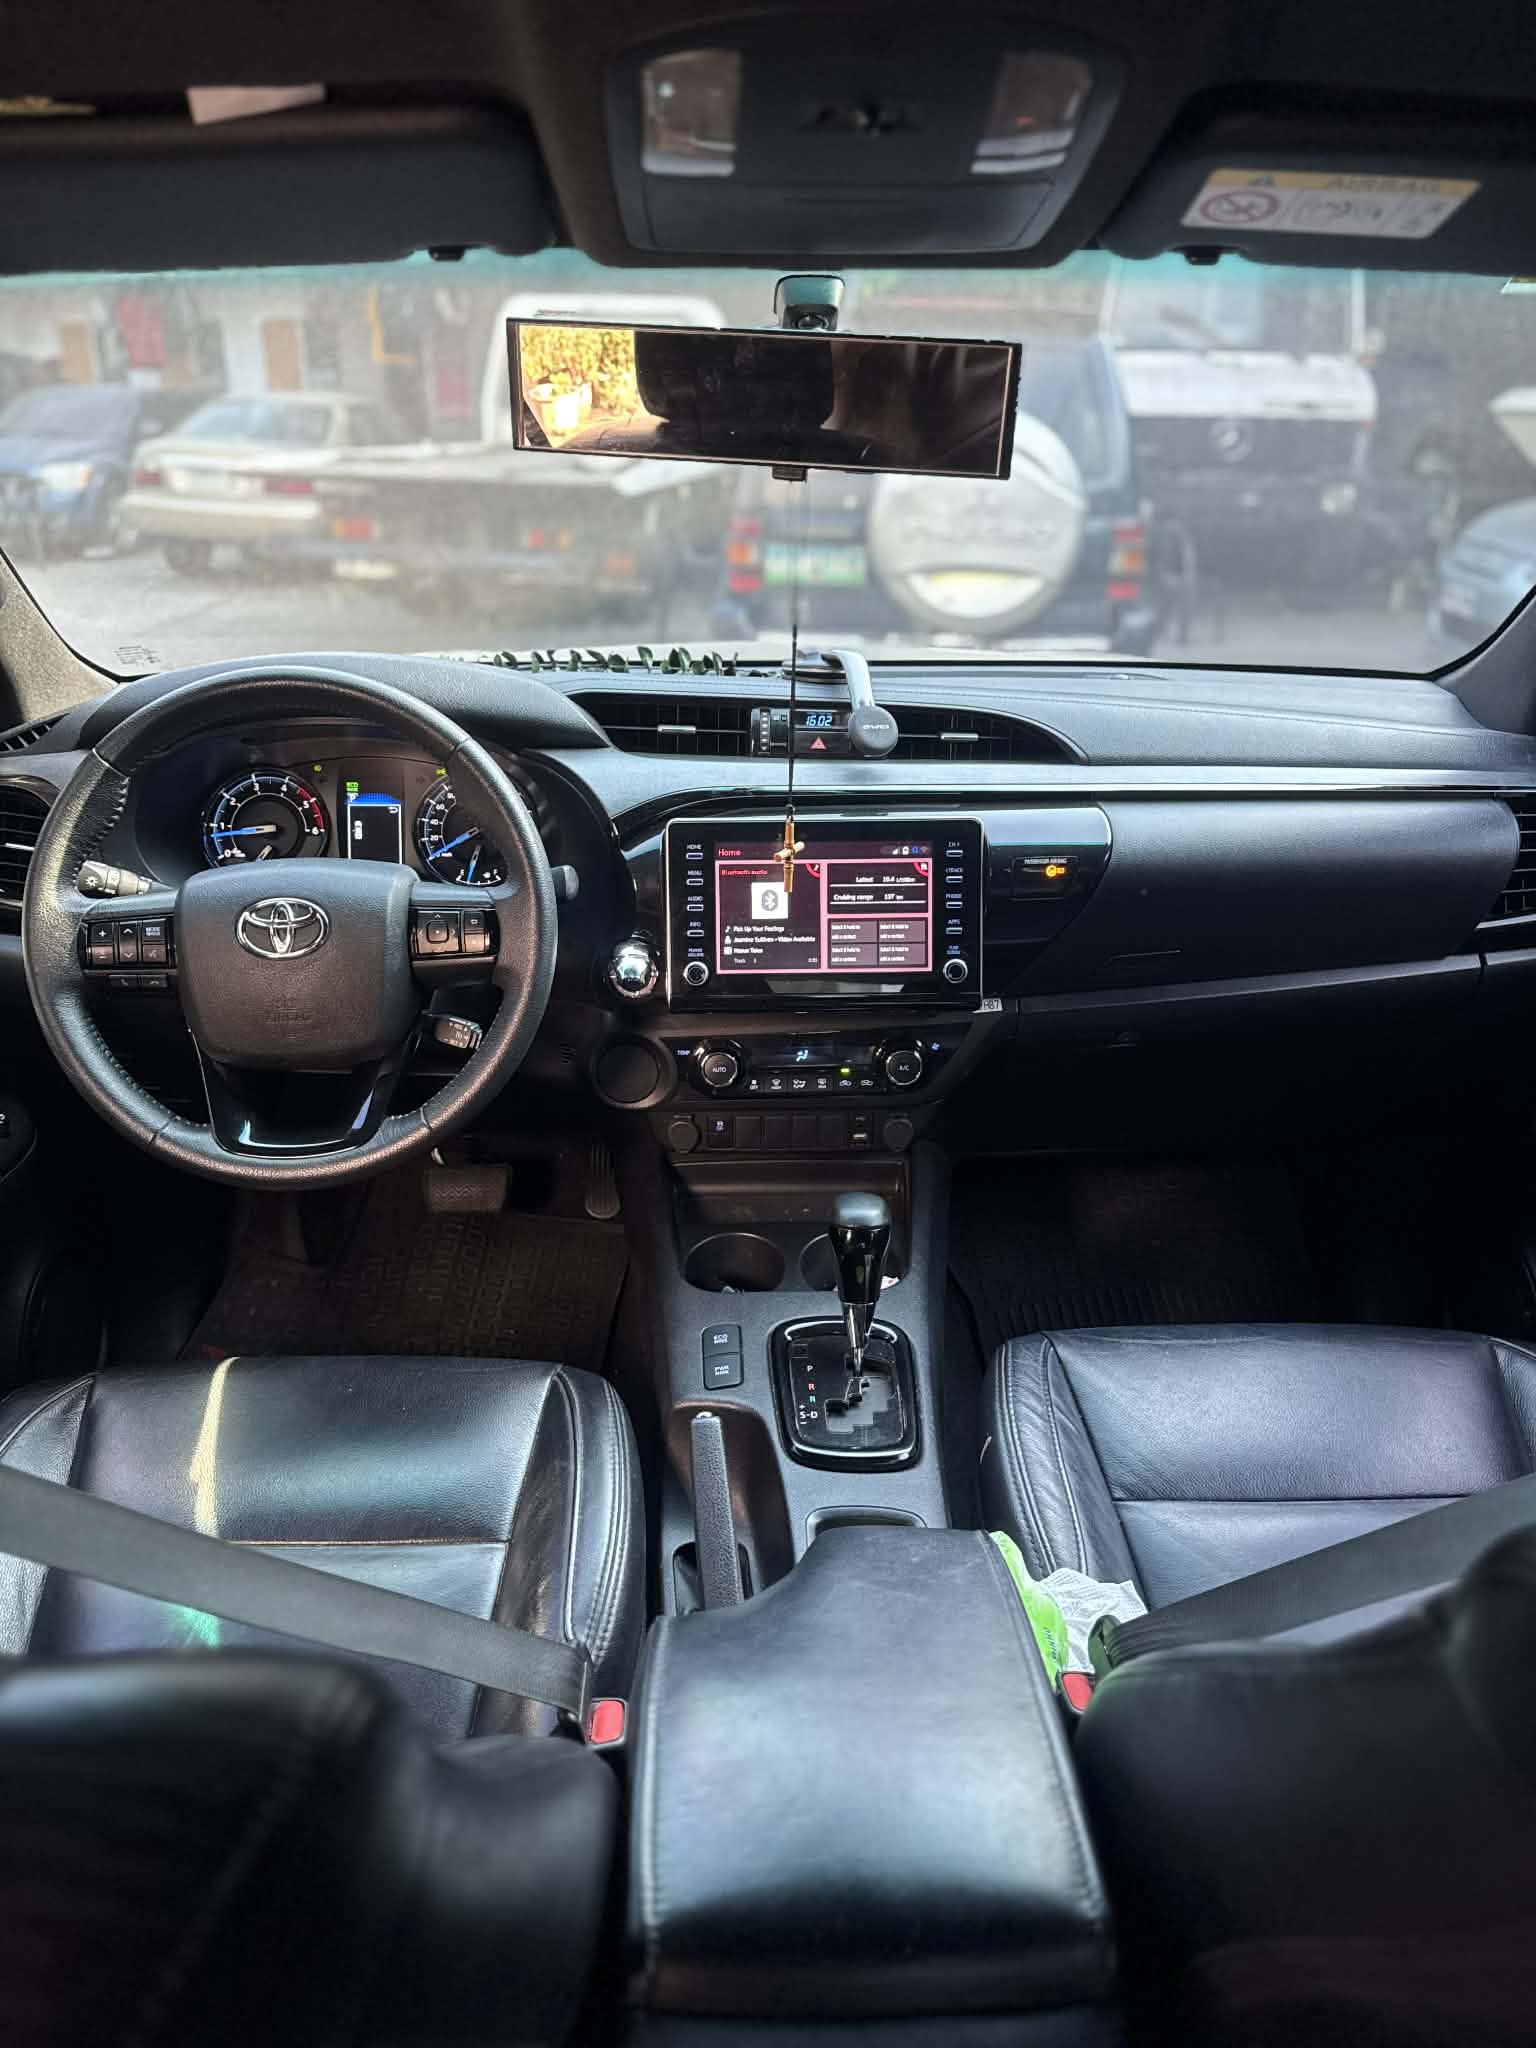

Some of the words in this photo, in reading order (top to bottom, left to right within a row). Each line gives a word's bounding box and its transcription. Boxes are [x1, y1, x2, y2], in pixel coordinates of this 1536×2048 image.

[254, 782, 260, 791] 3
[230, 798, 236, 806] 2
[304, 800, 310, 808] 5
[312, 826, 319, 835] 6
[718, 848, 742, 856] Home
